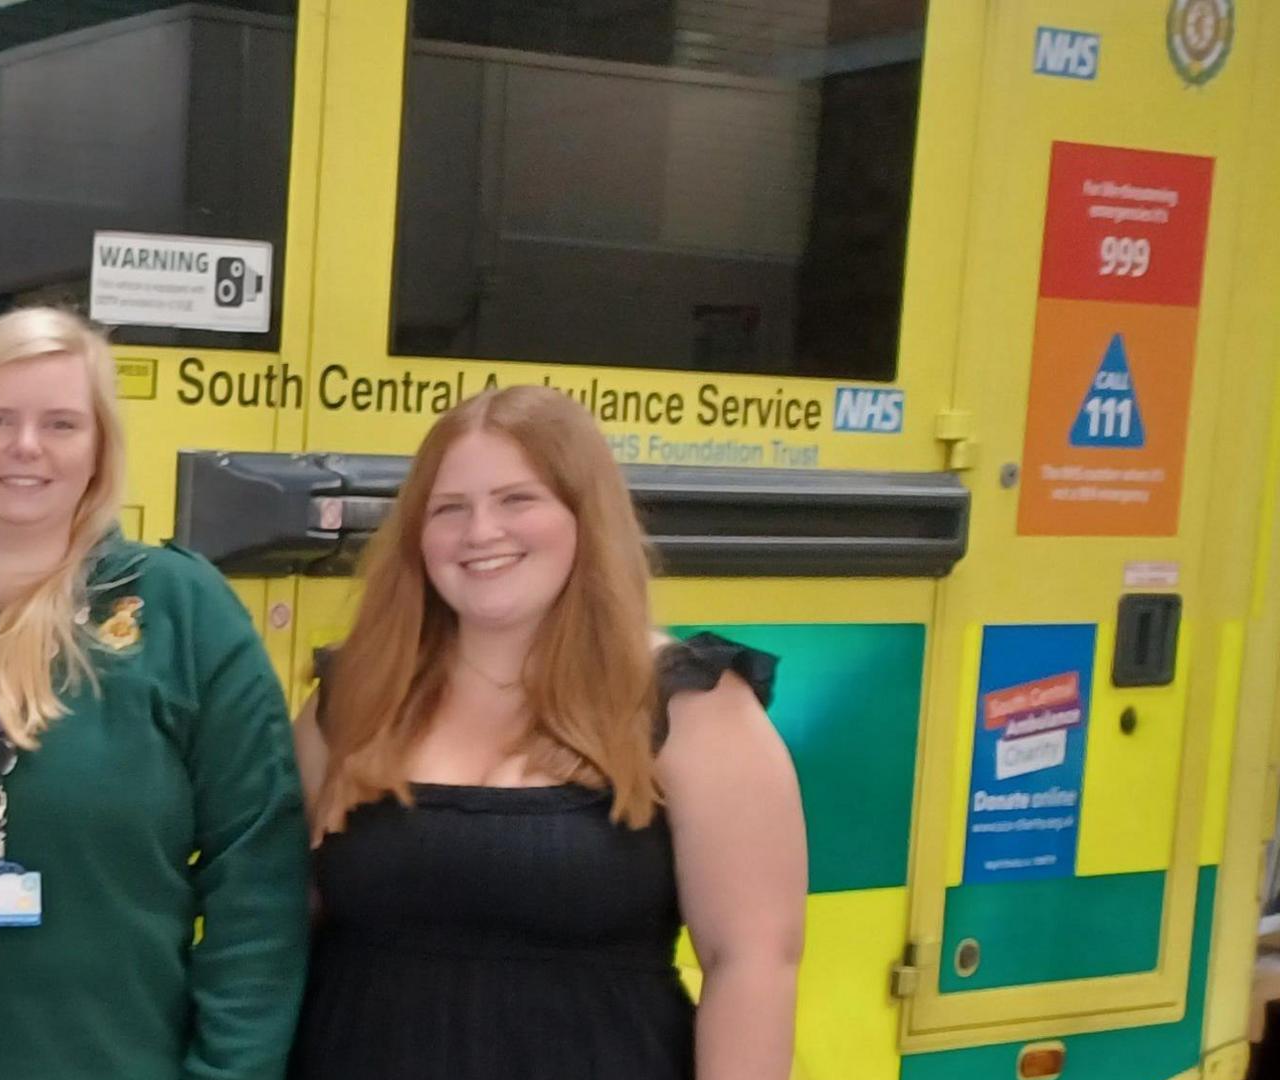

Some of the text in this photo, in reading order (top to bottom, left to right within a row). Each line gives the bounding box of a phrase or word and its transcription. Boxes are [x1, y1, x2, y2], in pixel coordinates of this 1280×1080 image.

[1035, 31, 1098, 76] NHS
[99, 245, 209, 274] WARNING
[1099, 236, 1151, 277] 999
[178, 357, 303, 410] South
[318, 363, 464, 414] Central
[697, 383, 821, 430] Service
[1094, 371, 1130, 390] CALL
[835, 388, 903, 432] NHS
[1085, 397, 1133, 438] 111
[649, 435, 764, 465] Foundation
[771, 438, 819, 467] Trust
[973, 790, 1030, 811] Donate
